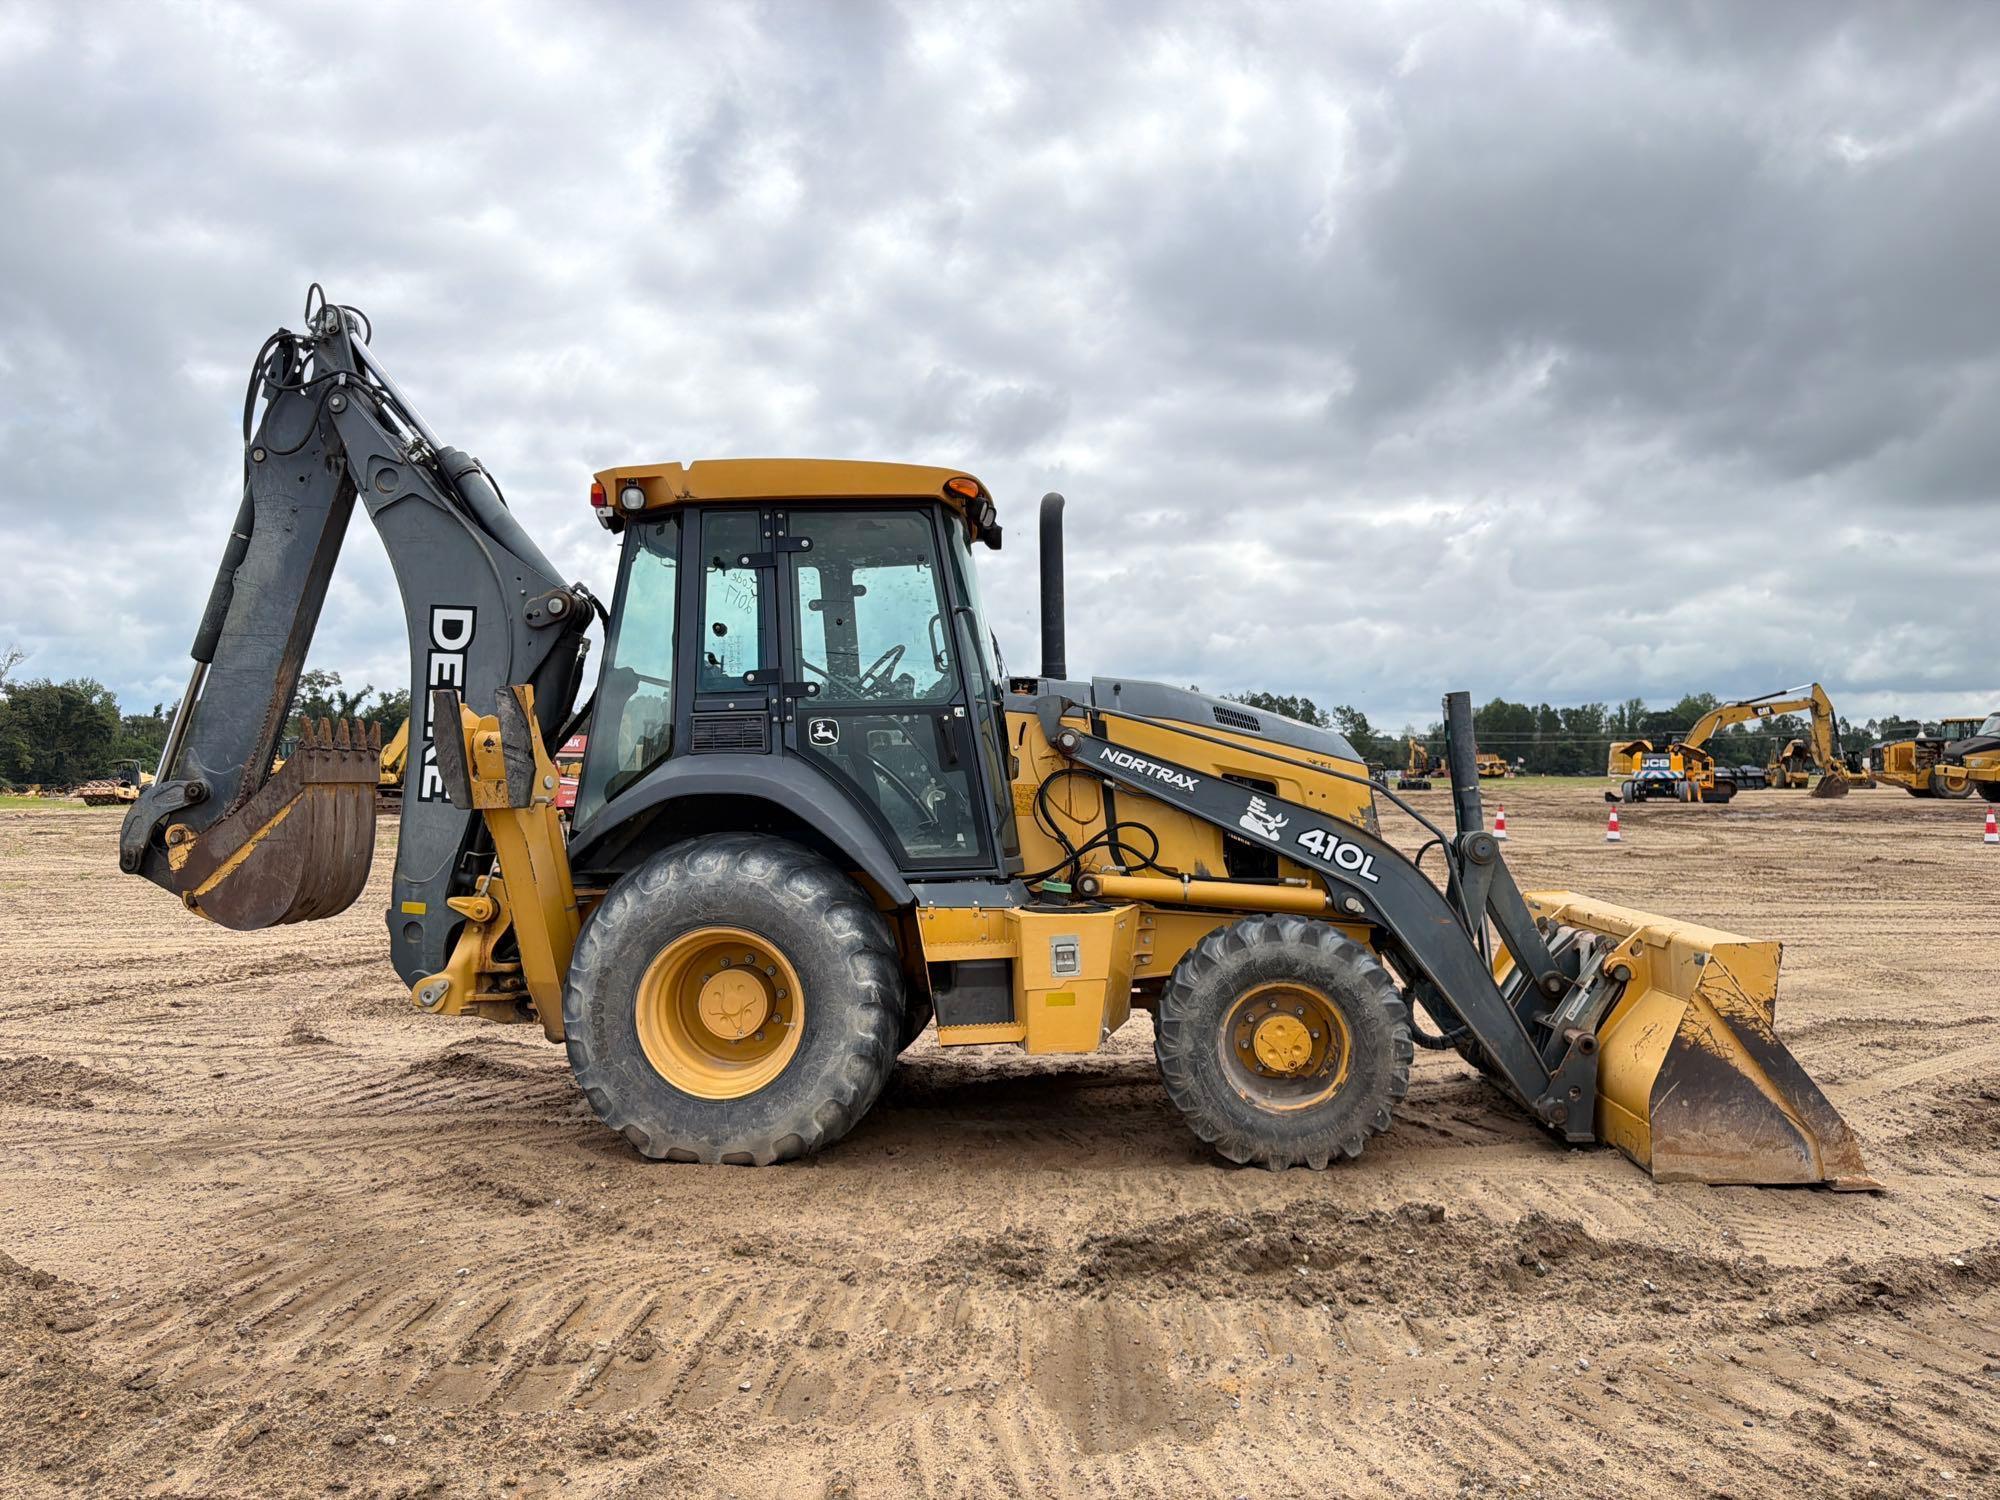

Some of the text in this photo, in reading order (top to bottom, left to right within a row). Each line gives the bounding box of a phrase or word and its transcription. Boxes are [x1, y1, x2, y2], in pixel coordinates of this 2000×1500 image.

[419, 605, 477, 802] DEE
[1757, 706, 1770, 716] CAT
[1099, 747, 1200, 791] NORTRAX
[1641, 759, 1670, 767] JCB
[1298, 828, 1380, 883] 410L
